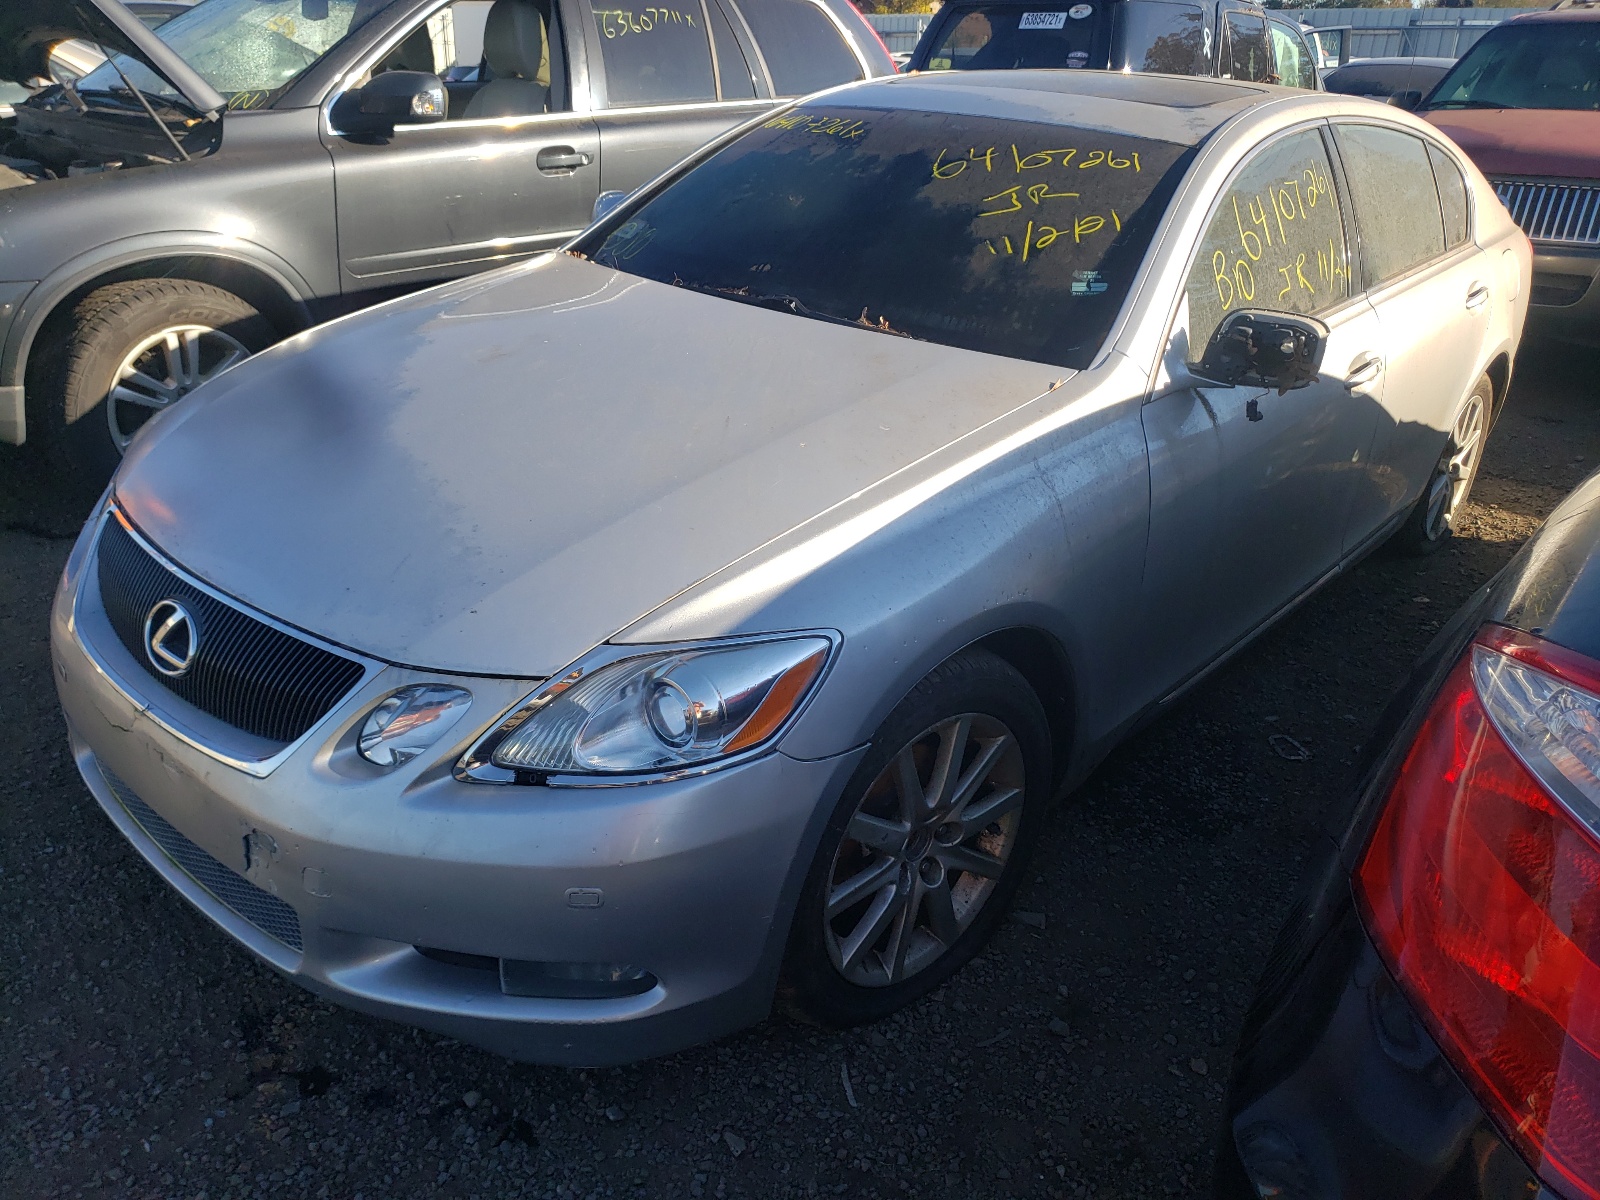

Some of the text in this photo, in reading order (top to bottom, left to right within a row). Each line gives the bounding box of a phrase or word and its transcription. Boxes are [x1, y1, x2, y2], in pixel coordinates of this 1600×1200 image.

[932, 144, 1141, 179] 64107261
[1232, 159, 1334, 261] 64107261
[1278, 253, 1315, 301] JR
